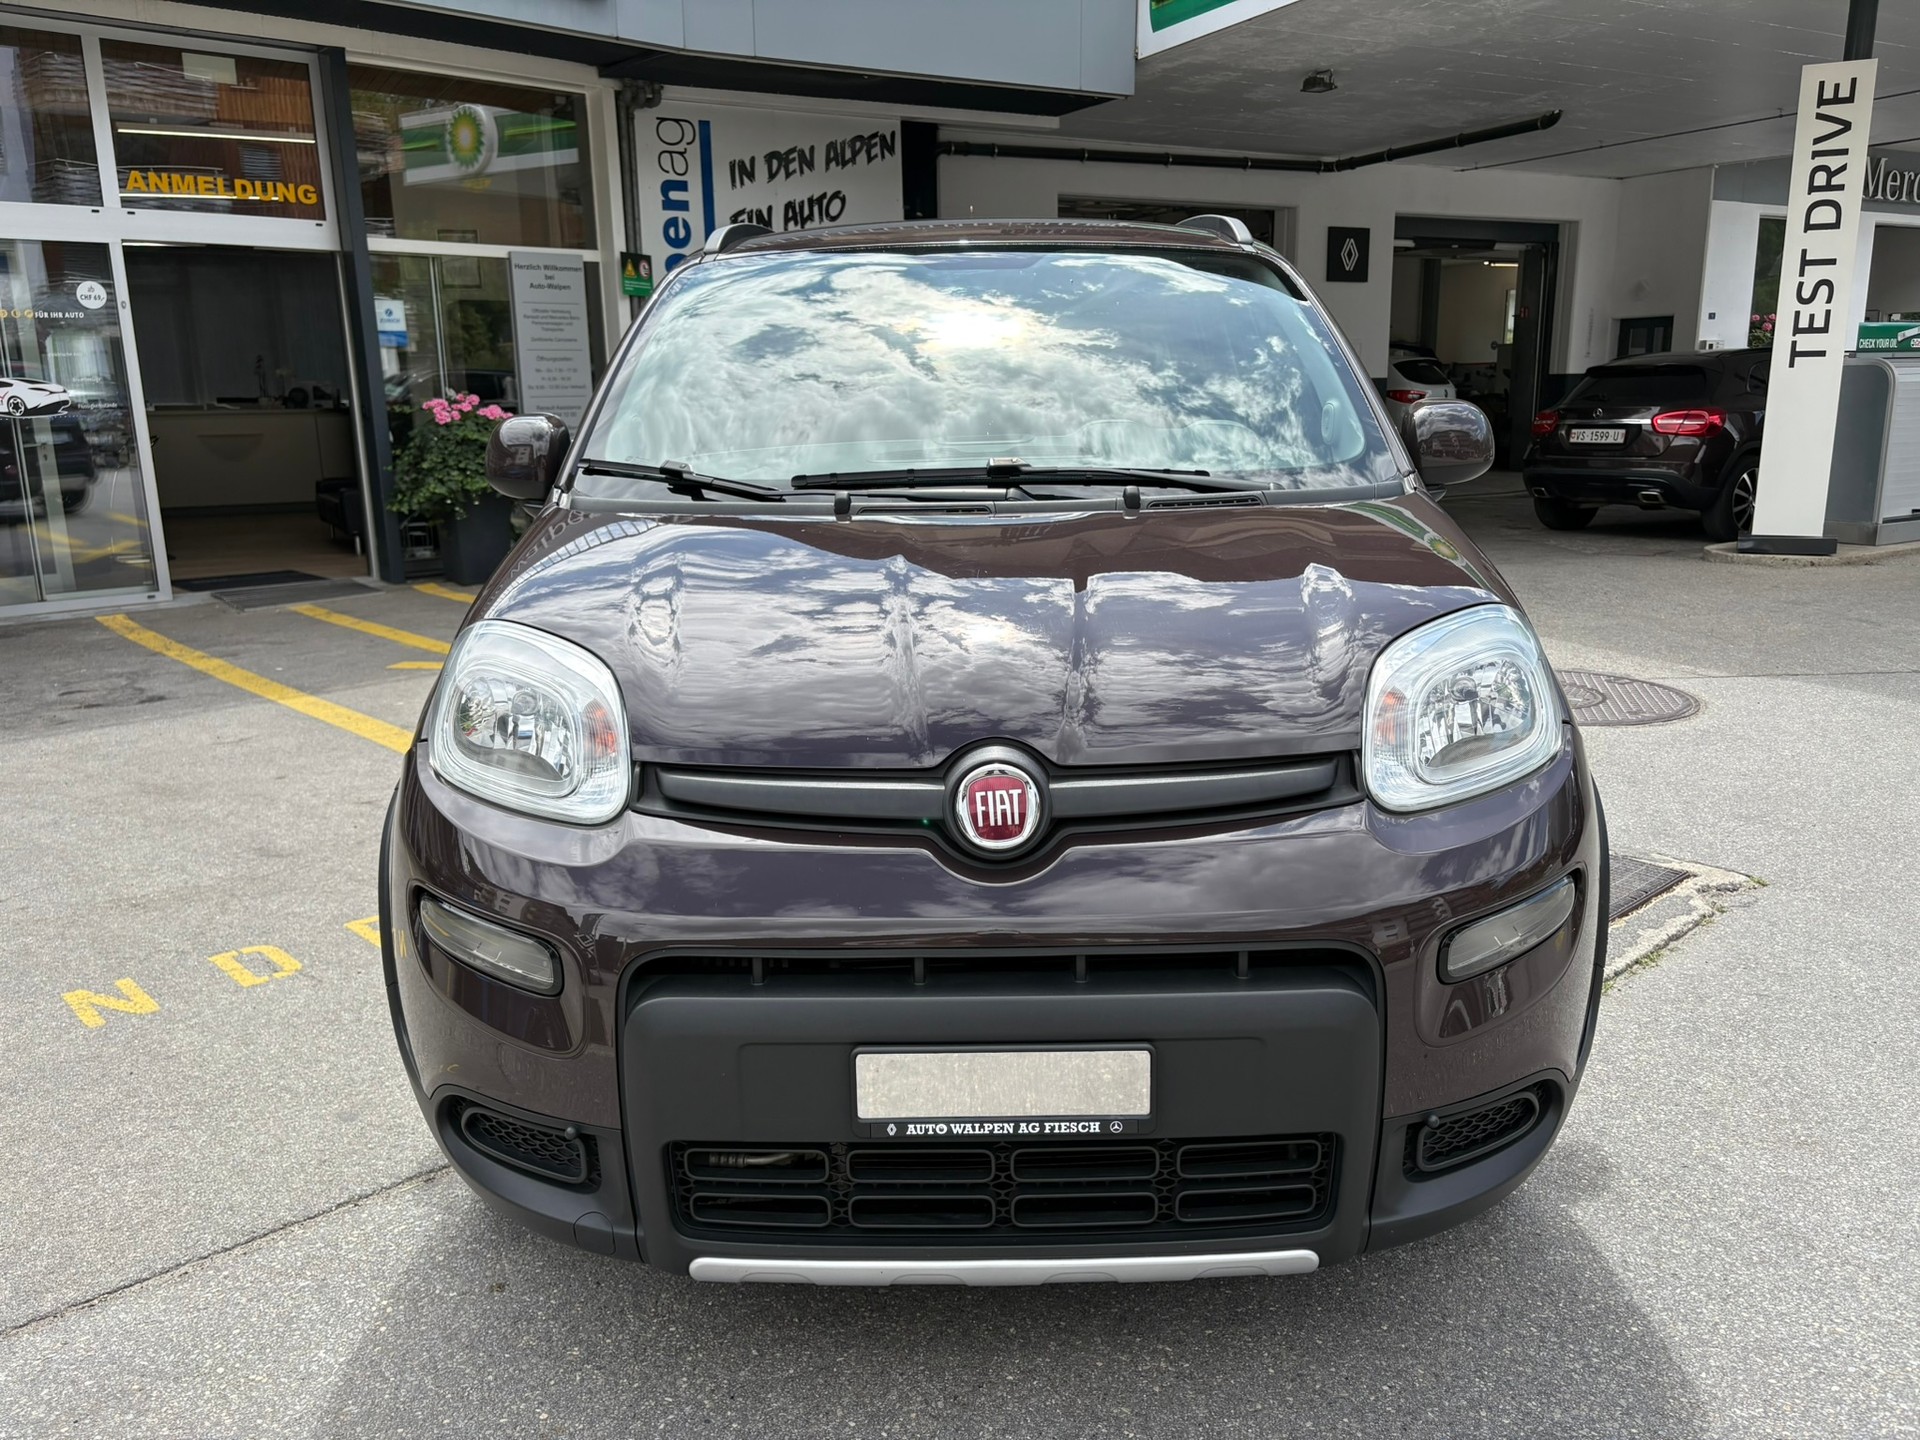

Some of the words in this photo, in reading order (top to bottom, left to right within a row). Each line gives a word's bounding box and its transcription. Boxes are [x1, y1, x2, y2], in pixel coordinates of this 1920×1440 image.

[728, 155, 756, 191] IN
[763, 145, 815, 184] DEN
[825, 130, 896, 173] ALPEN
[1803, 77, 1857, 233] DRIVE
[126, 170, 318, 205] ANMELDUNG
[783, 190, 847, 232] AUTO
[514, 263, 541, 271] Herzlich
[543, 264, 583, 273] Willkommen
[544, 273, 555, 281] bei
[79, 293, 92, 301] CHF
[1788, 248, 1837, 368] TEST
[34, 310, 49, 319] FÜR
[50, 311, 64, 319] IHR
[64, 311, 85, 319] AUTO
[1859, 338, 1876, 349] CHECK
[1876, 338, 1890, 349] YOUR
[1890, 338, 1898, 349] OIL
[975, 788, 1022, 828] FIAT
[905, 1123, 948, 1135] AUTO
[950, 1123, 1014, 1135] WALPEN
[1018, 1122, 1040, 1134] AG
[1044, 1121, 1101, 1134] FIESCH
